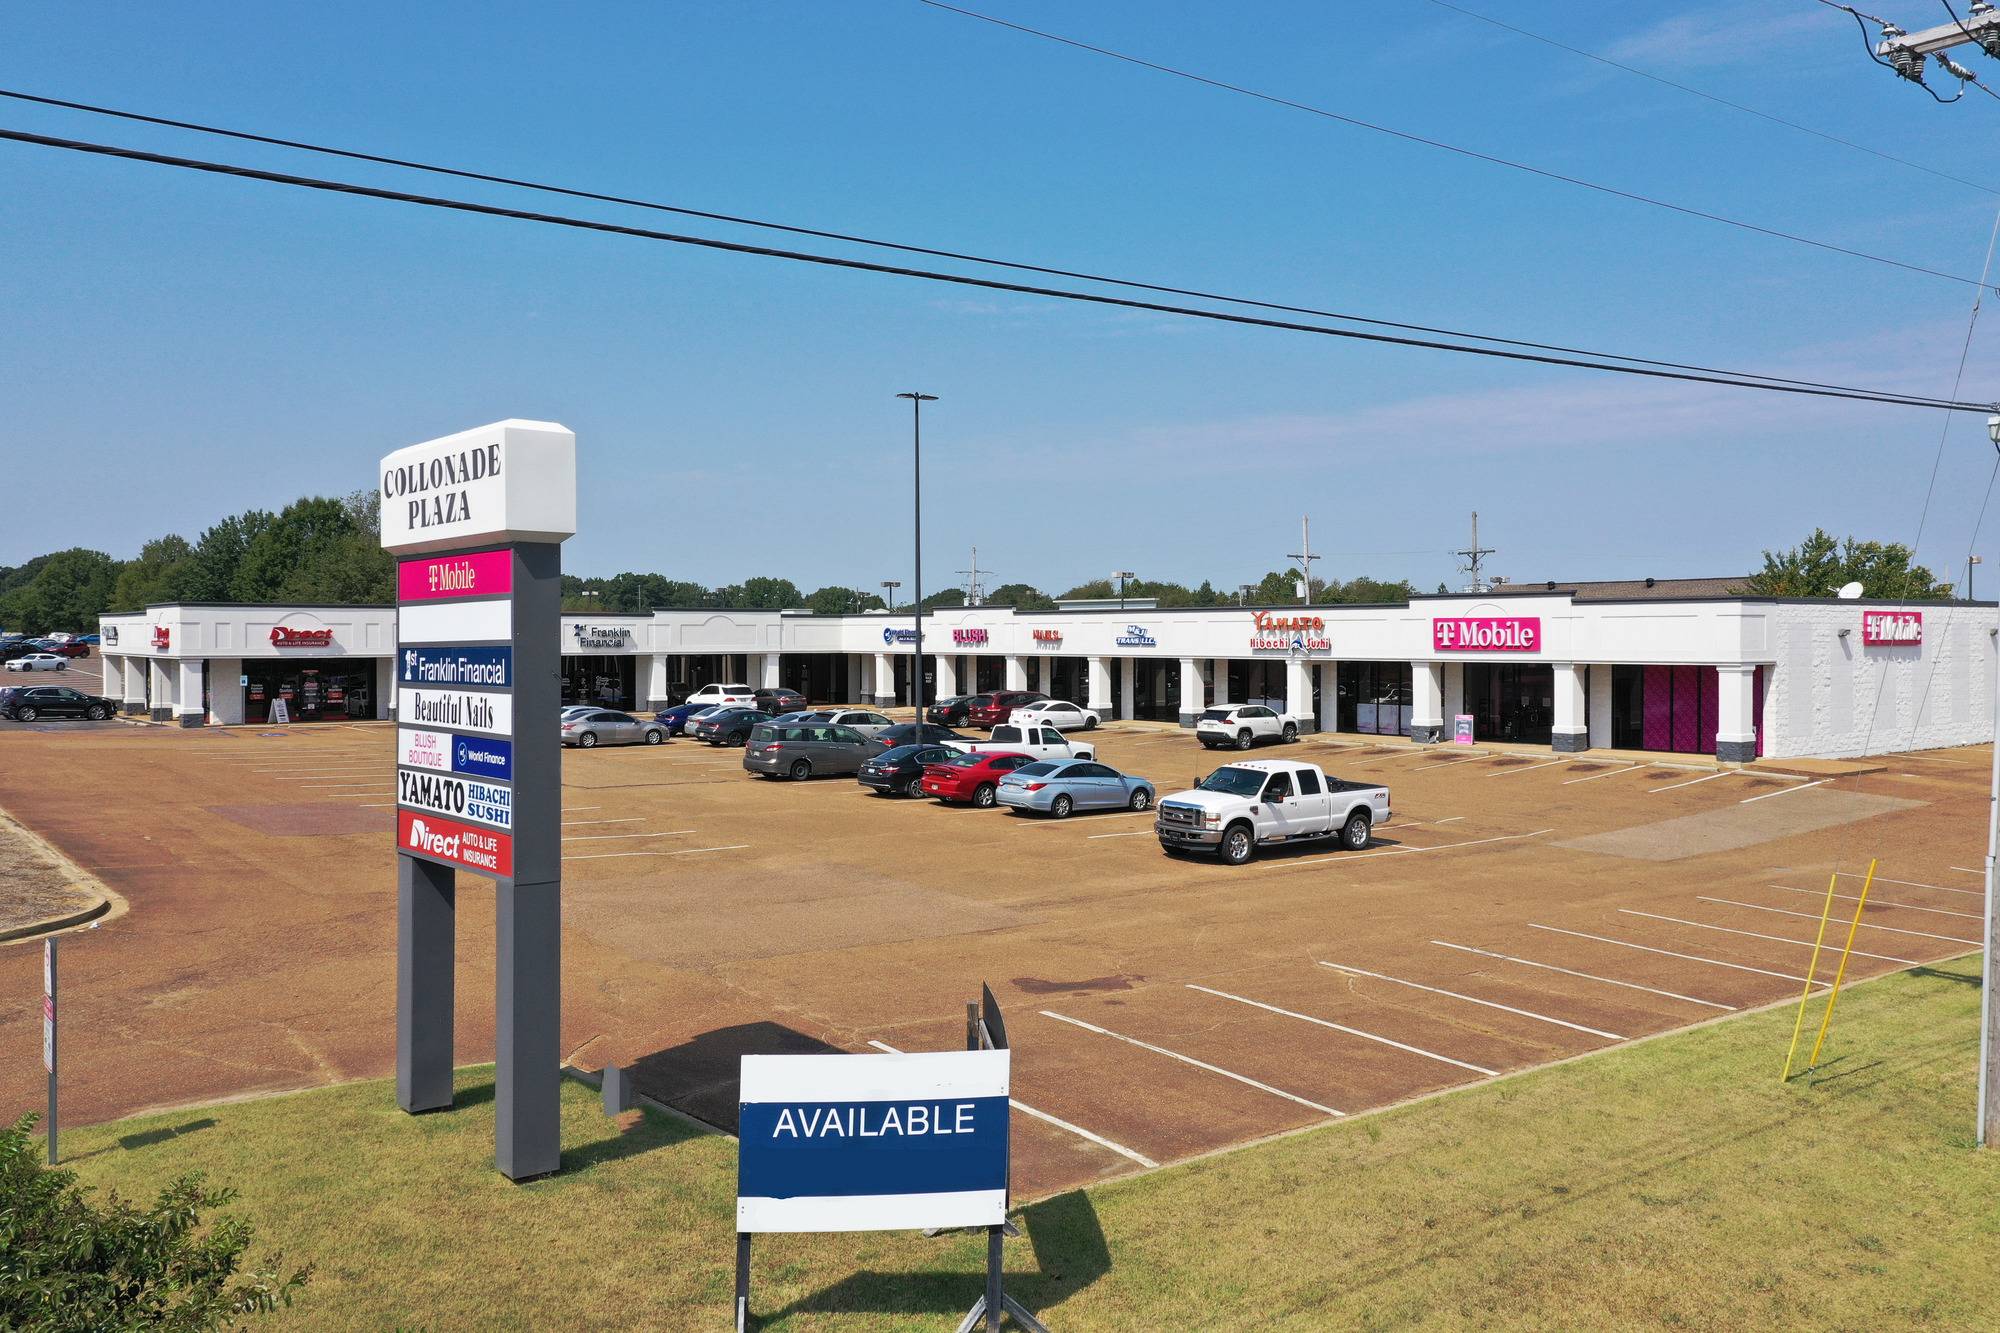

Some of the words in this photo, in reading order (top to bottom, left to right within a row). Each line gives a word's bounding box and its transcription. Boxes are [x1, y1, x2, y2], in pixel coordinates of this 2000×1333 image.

[384, 443, 501, 499] COLLONADE
[408, 490, 471, 530] PLAZA
[439, 561, 475, 591] Mobile
[1251, 610, 1325, 631] YAMATO
[580, 637, 625, 648] Financial
[591, 627, 631, 638] Franklin
[953, 628, 988, 643] BLUSH
[1437, 621, 1455, 646] T
[1459, 621, 1534, 647] Mobile
[1250, 638, 1289, 649] Hibachi
[419, 657, 457, 682] Franklin
[458, 657, 505, 684] Financial
[414, 692, 462, 725] Beautiful
[466, 696, 493, 729] Nails
[415, 733, 436, 749] BLUSH
[409, 749, 442, 767] BOUTIQUE
[468, 750, 484, 762] World
[484, 751, 506, 766] Finance
[400, 771, 465, 813] YAMATO
[468, 783, 511, 807] HIBACHI
[467, 803, 510, 824] SUSHI
[410, 818, 460, 859] Direct
[462, 832, 479, 847] AUTO
[484, 837, 498, 852] LIFE
[463, 848, 497, 869] INSURANCE
[772, 1104, 975, 1138] AVAILABLE
